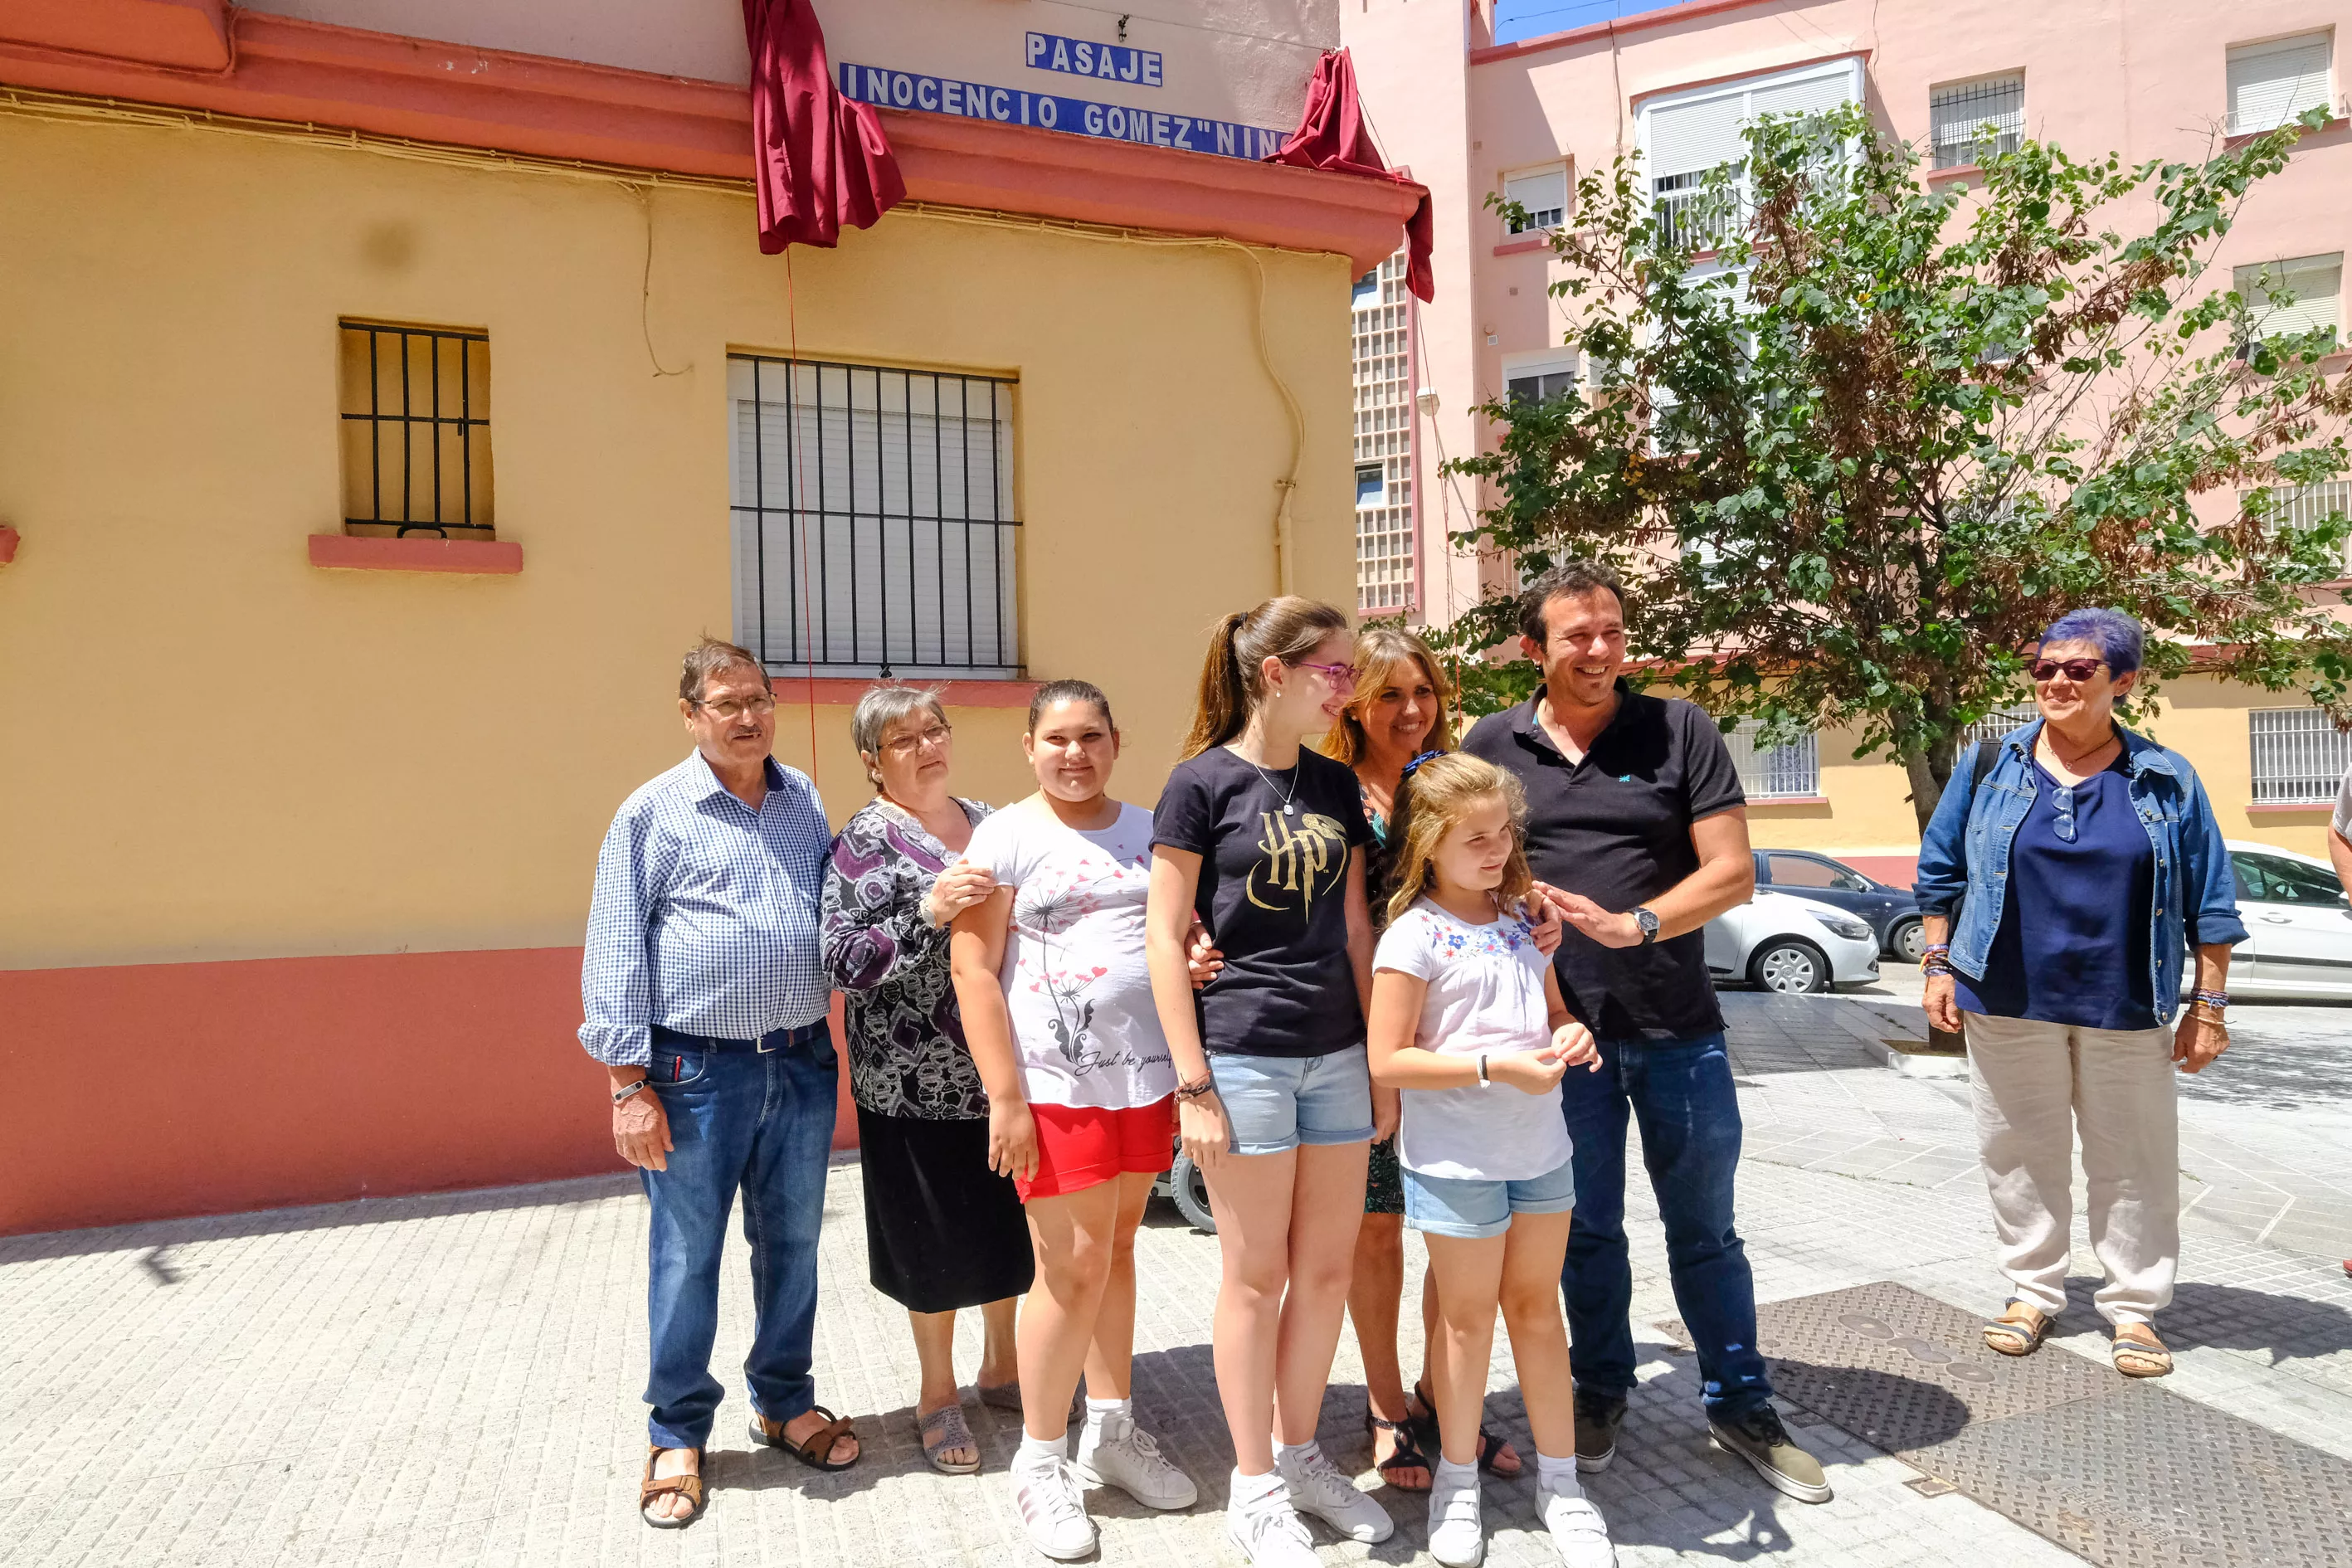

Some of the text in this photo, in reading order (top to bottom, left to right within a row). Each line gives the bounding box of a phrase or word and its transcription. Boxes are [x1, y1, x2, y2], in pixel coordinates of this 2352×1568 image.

[1027, 33, 1161, 86] PASAJE
[847, 65, 1058, 128] INOCENCIO
[1074, 1050, 1121, 1077] Just
[1122, 1050, 1136, 1066] be
